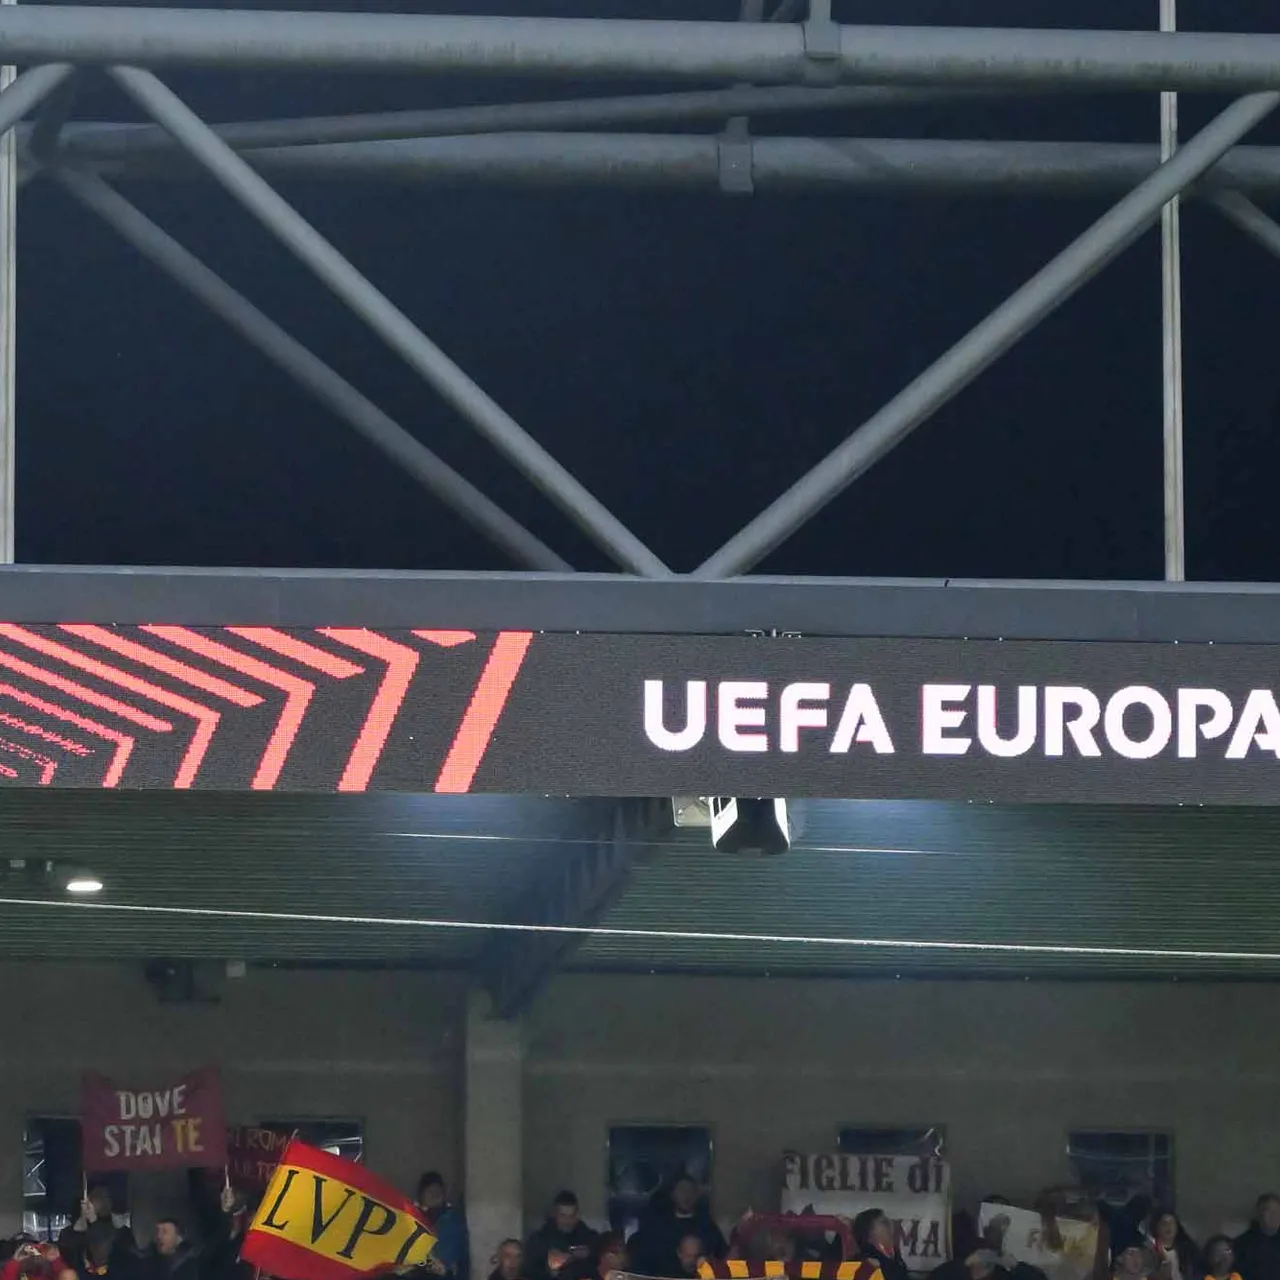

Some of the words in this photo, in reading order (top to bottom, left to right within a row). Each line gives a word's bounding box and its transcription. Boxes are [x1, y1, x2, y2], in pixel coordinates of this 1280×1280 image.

[644, 679, 894, 755] UEFA
[117, 1084, 187, 1121] DOVE
[105, 1124, 162, 1158] STAI
[173, 1118, 204, 1153] TE
[784, 1153, 894, 1193] FIGLIE
